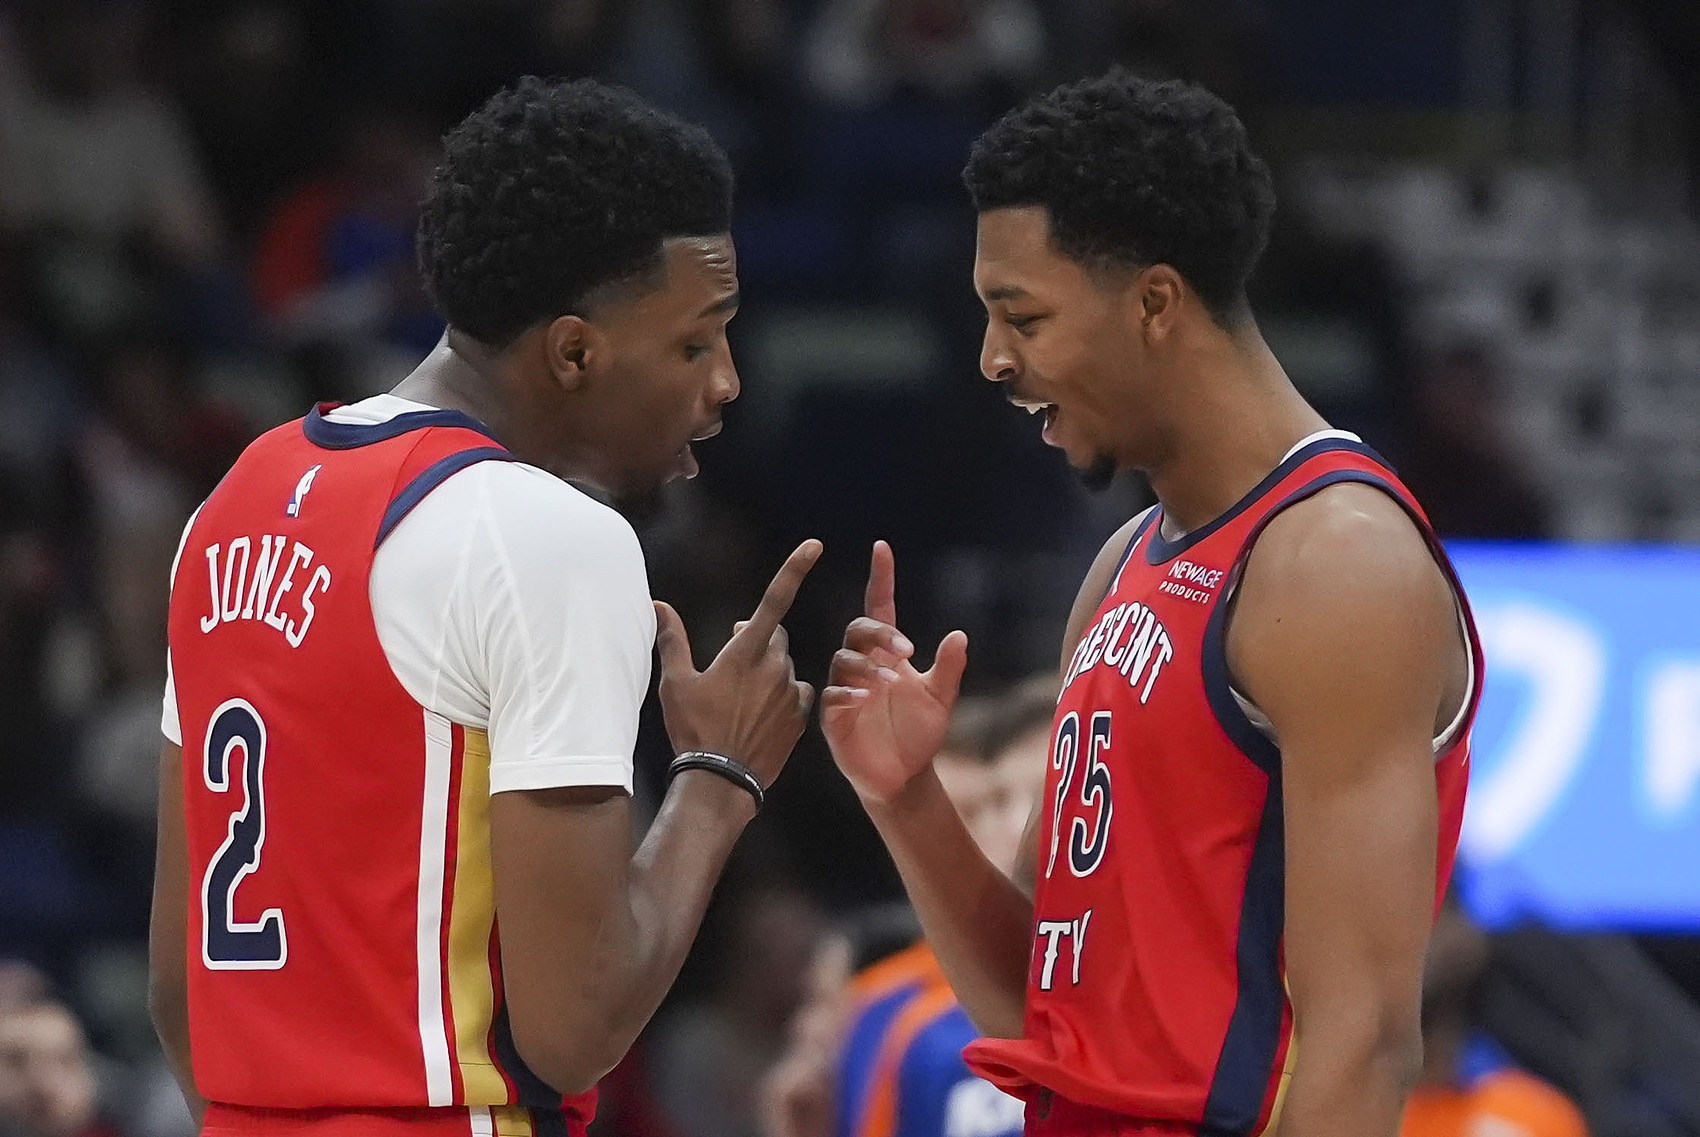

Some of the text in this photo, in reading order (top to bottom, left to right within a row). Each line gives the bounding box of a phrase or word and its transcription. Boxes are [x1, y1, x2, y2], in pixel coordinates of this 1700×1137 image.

[200, 534, 332, 649] JONES
[1158, 580, 1211, 604] PRODUCTS
[1167, 560, 1224, 589] NEWAGE
[201, 697, 288, 971] 2
